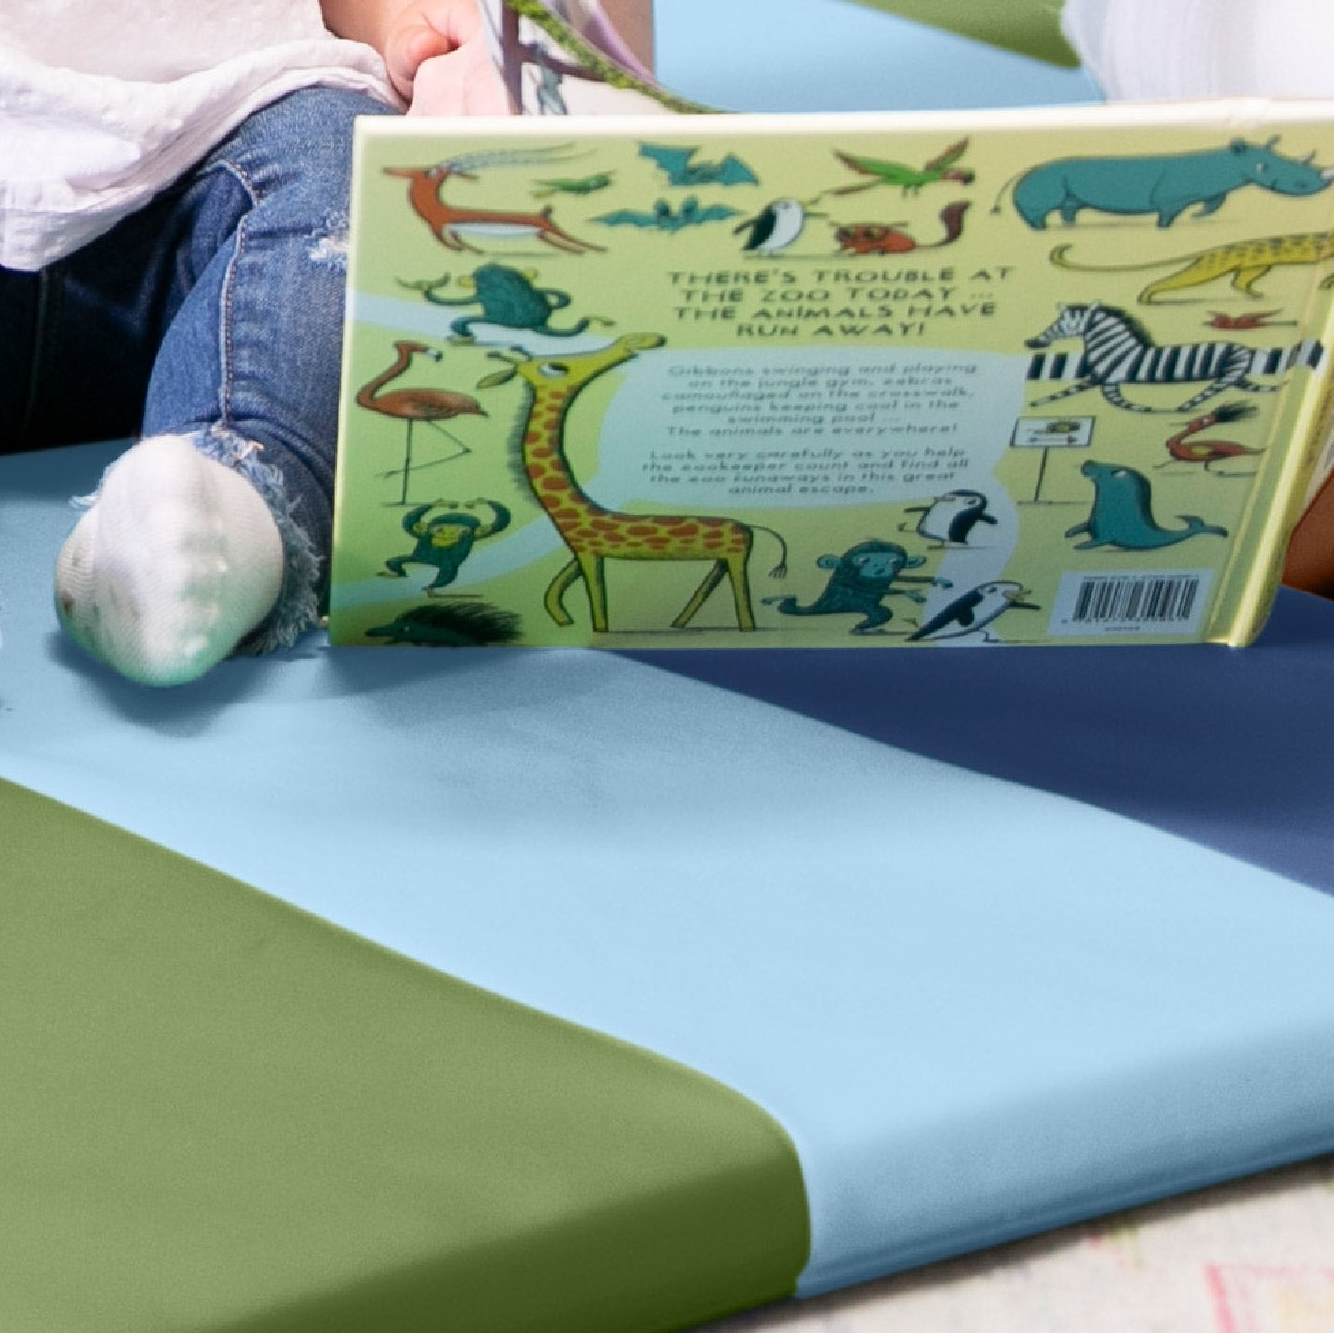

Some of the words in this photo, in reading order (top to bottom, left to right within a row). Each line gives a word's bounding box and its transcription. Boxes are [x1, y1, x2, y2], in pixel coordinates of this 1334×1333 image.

[667, 268, 797, 284] THERE'S
[813, 266, 956, 283] TROUBLE
[971, 265, 1016, 281] AT
[678, 288, 744, 303] THE
[761, 288, 830, 302] ZOO
[846, 286, 957, 302] TODAY
[672, 306, 737, 321] THE
[752, 304, 894, 320] ANIMALS
[907, 302, 997, 318] HAVE
[736, 323, 799, 338] RUN
[813, 321, 926, 337] AWAY!
[858, 362, 896, 375] and
[902, 362, 978, 376] playing
[719, 376, 751, 388] the
[757, 376, 819, 390] jungle
[828, 388, 860, 399] the
[928, 399, 961, 410] the
[668, 426, 703, 438] The
[642, 461, 673, 472] the
[856, 459, 894, 471] and
[649, 473, 681, 484] the
